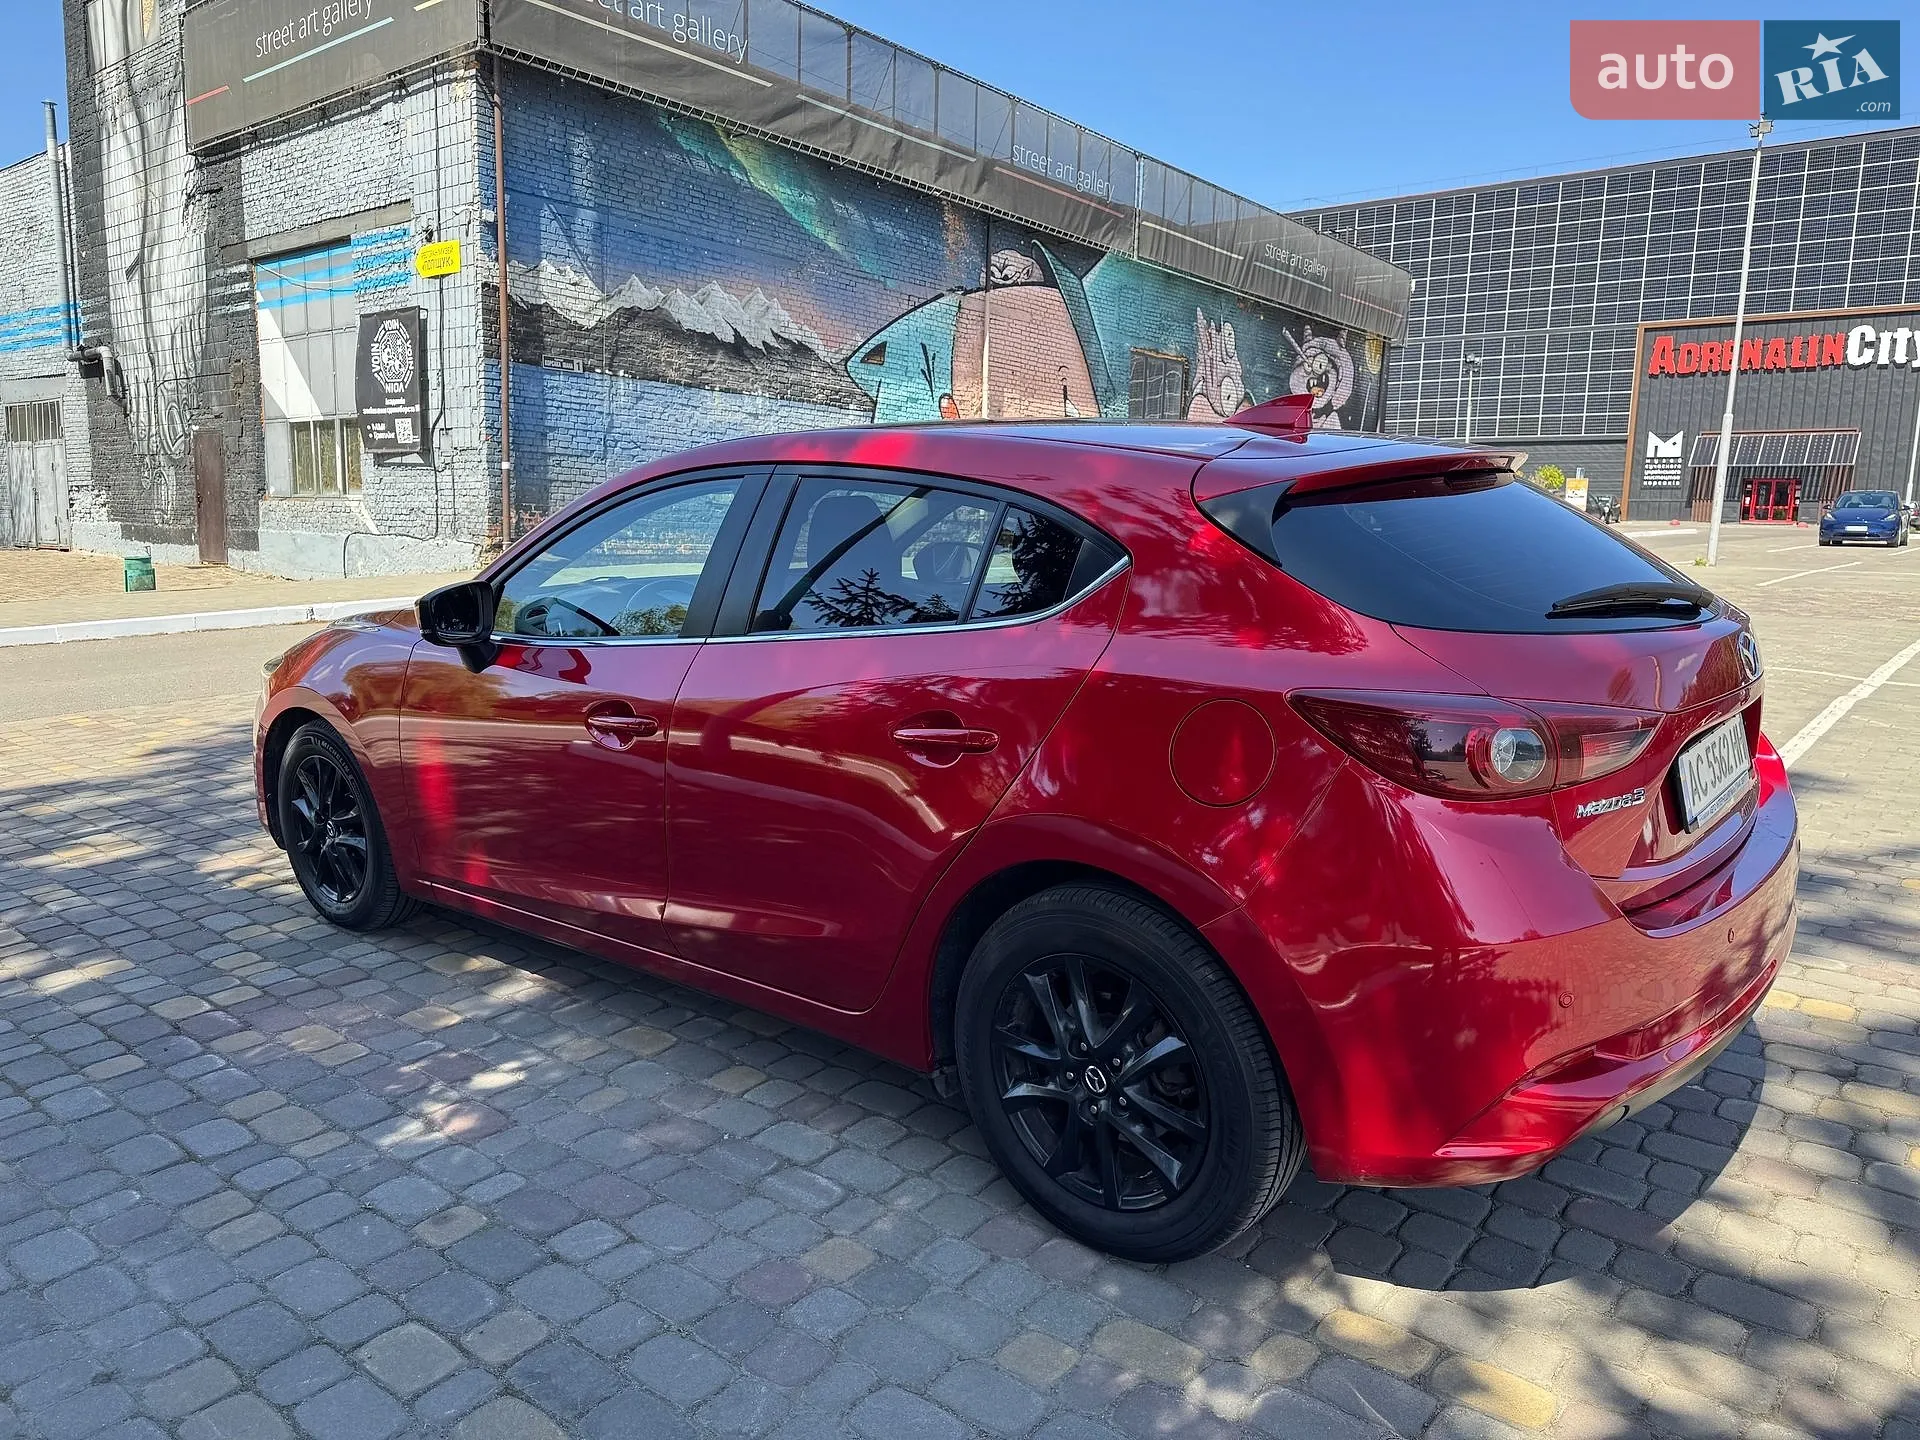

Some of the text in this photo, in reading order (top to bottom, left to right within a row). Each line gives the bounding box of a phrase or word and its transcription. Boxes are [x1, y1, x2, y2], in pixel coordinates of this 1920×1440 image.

[256, 0, 372, 58] street art gallery
[630, 2, 748, 65] art gallery
[1012, 143, 1116, 204] street art gallery
[1264, 243, 1329, 282] street art gallery
[383, 319, 400, 331] VOIN
[371, 343, 381, 373] VOIN
[406, 340, 415, 370] VOIN
[385, 381, 405, 393] VOIN
[1688, 753, 1708, 807] AC
[1705, 731, 1733, 789] 5562
